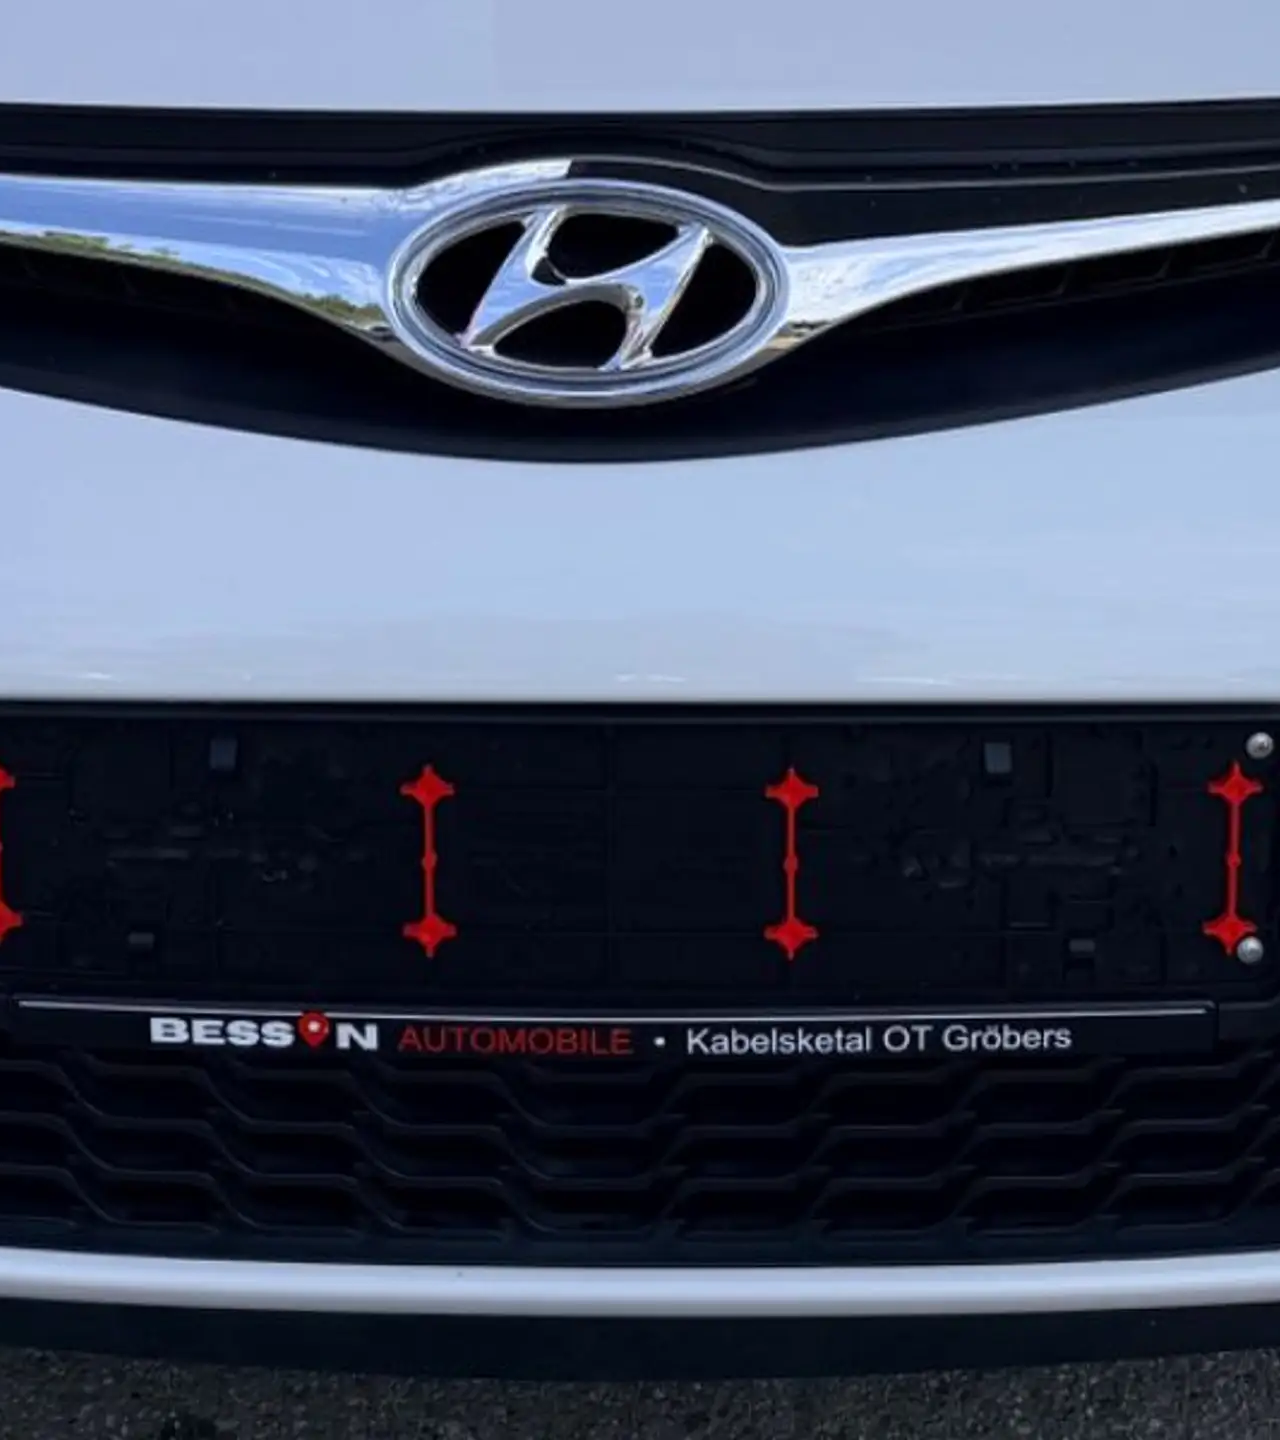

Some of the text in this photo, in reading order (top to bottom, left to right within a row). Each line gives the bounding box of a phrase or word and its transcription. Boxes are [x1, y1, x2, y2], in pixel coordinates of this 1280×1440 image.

[398, 1025, 633, 1055] AUTOMOBILE
[686, 1027, 871, 1054] Kabelsketal
[883, 1025, 933, 1051] OT
[942, 1024, 1072, 1051] Gröbers
